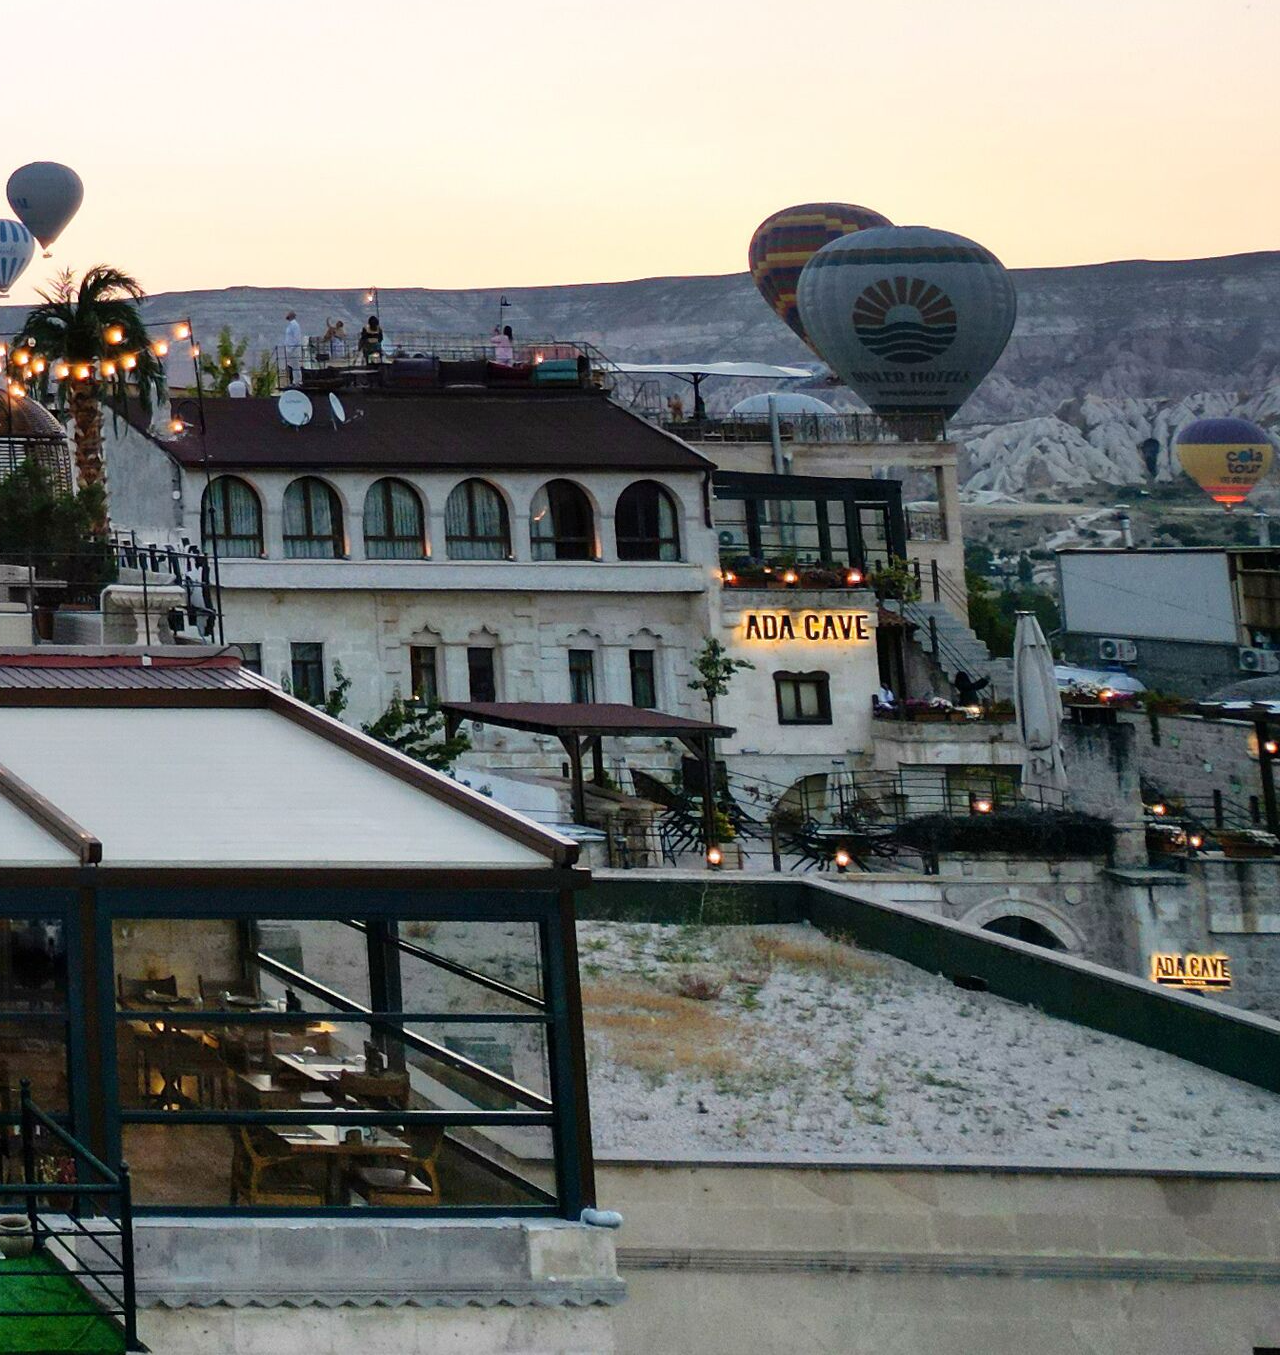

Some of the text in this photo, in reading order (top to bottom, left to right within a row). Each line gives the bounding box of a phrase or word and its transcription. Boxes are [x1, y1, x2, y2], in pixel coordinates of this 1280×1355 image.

[746, 614, 870, 641] ADA CAVE
[1156, 957, 1230, 978] ADA CAVE
